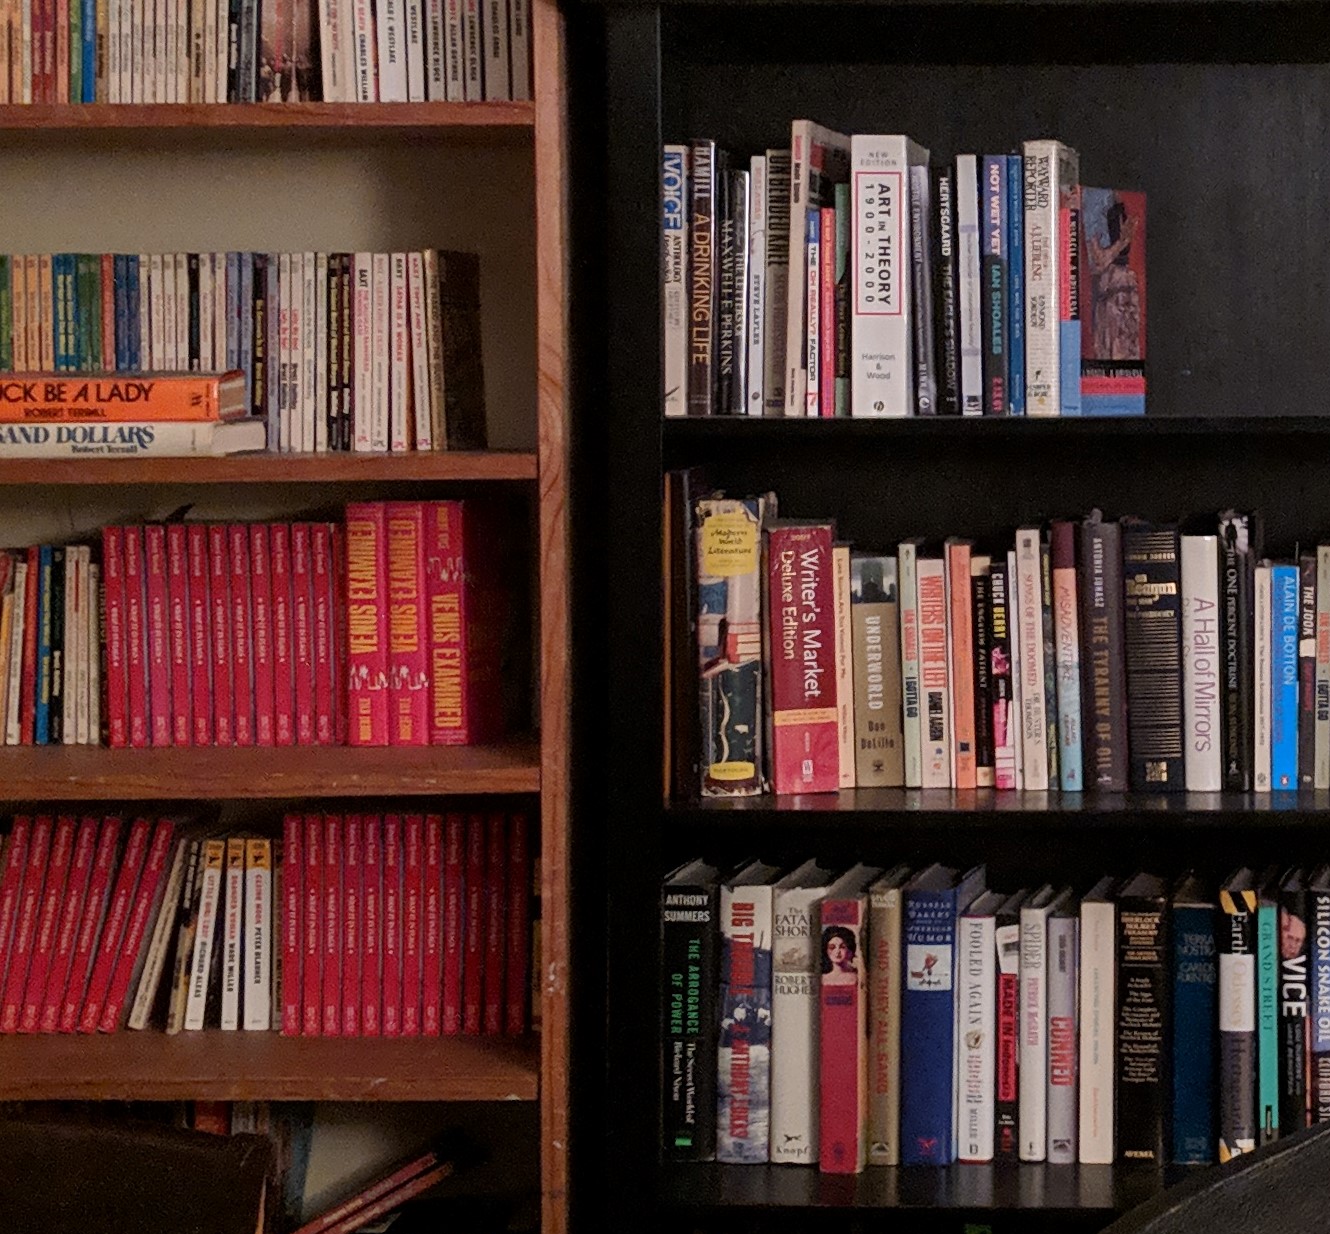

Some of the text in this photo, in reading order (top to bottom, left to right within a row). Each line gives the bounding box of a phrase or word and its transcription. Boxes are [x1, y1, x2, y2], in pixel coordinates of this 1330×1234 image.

[990, 164, 1001, 256] NOT WET YET
[1025, 156, 1036, 210] REPORTER
[693, 147, 711, 364] HAMILL A DRINKING LIFE
[810, 271, 816, 286] OH
[878, 184, 891, 305] ART IN THEORY
[992, 265, 1002, 355] IAN SHOALES
[45, 384, 66, 402] BE
[73, 384, 89, 402] A
[97, 383, 154, 402] LADY
[56, 426, 154, 449] DOLLARS
[389, 520, 418, 653] VENUS EXAMINED
[781, 551, 796, 659] Deluxe Edition
[801, 549, 822, 697] Writer's Market
[991, 573, 1006, 638] CHUCK BERRY
[1283, 576, 1295, 684] ALAIN DE BOTTON
[431, 593, 462, 727] VENUS EXAMINED
[869, 615, 883, 710] UNDERWORLD
[1093, 617, 1111, 768] THE TYRANNY OF OIL
[1194, 598, 1215, 751] A Hall of Mirrors
[194, 941, 206, 998] RICHARD ALEAS
[254, 927, 262, 984] PETER BLAUNER
[731, 903, 753, 996] BIG TROUBLE
[969, 923, 982, 1024] FOOLED AGAIN
[1316, 896, 1330, 960] SILICON
[671, 974, 683, 1033] OF POWER
[687, 939, 700, 1033] THE ARROGANCE
[1262, 922, 1272, 1031] GRAND STREET
[1282, 954, 1307, 1017] VICE
[1317, 965, 1330, 1012] SNAKE
[1051, 1016, 1073, 1085] CONNED
[1318, 1017, 1330, 1042] OIL
